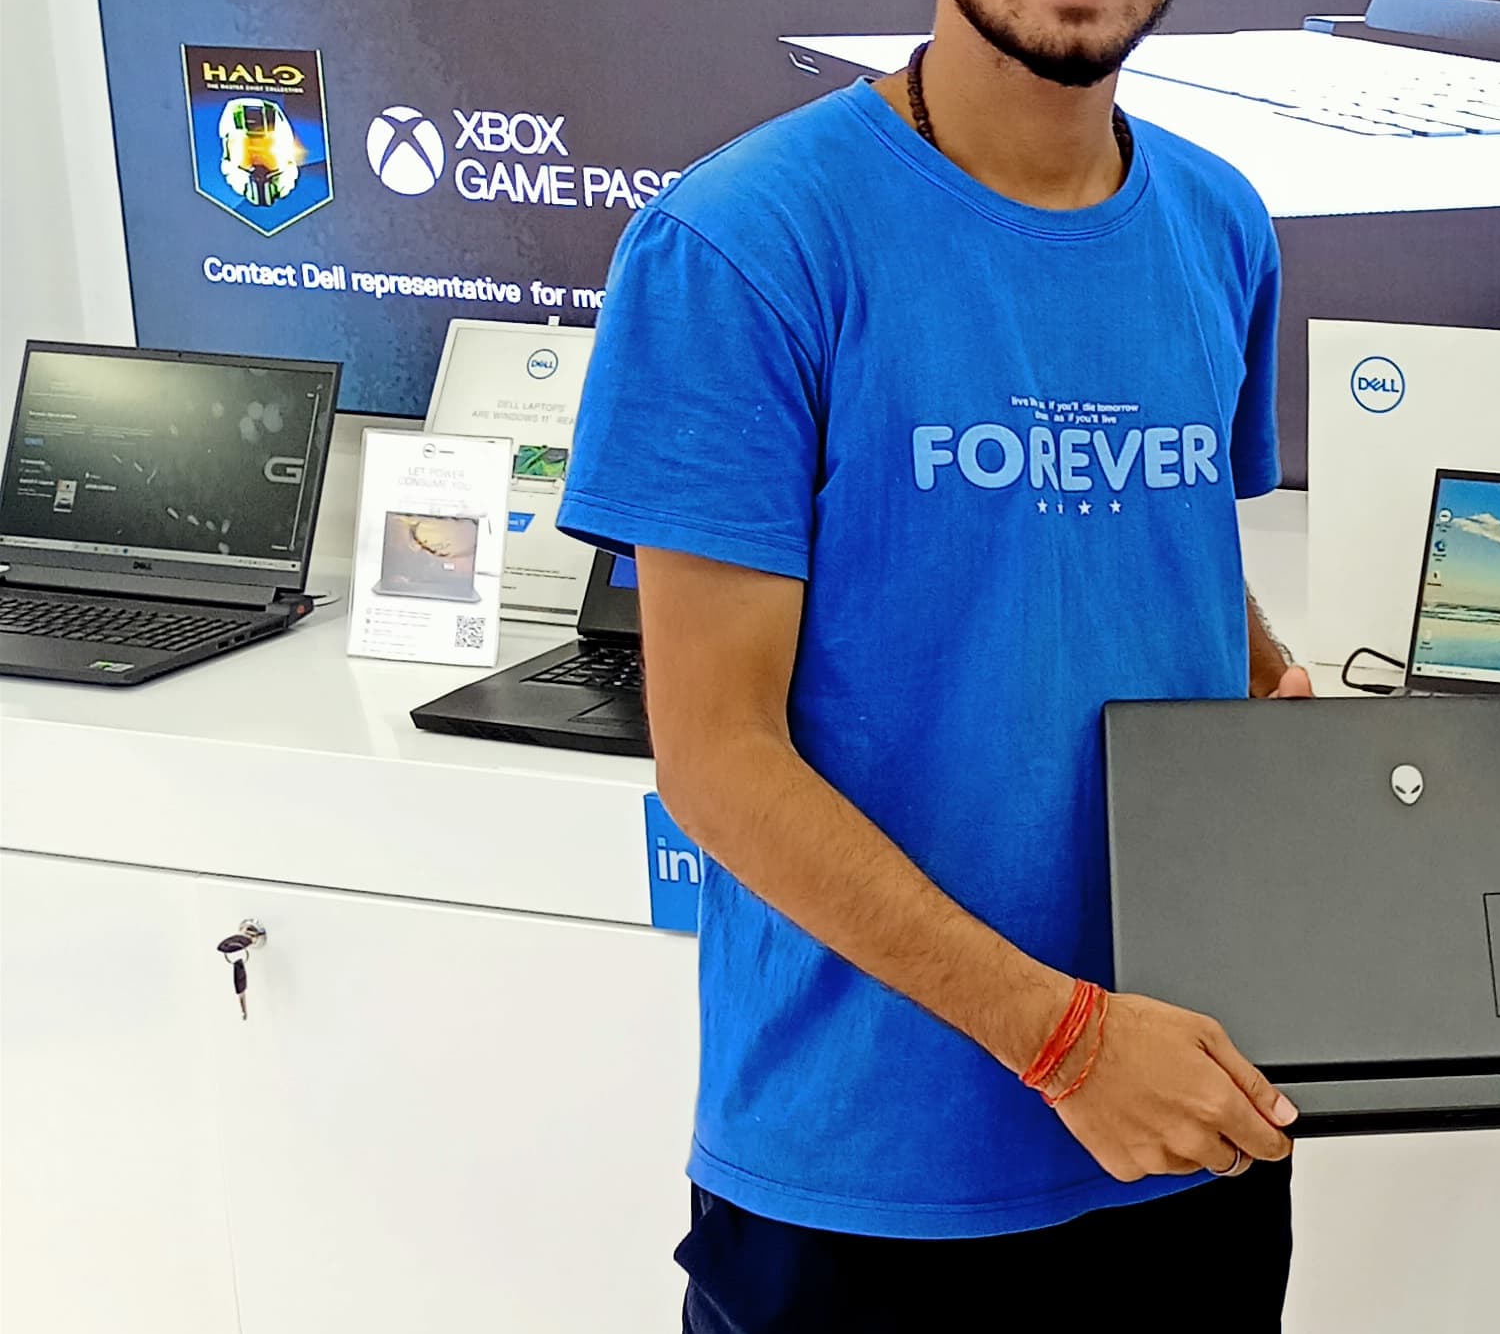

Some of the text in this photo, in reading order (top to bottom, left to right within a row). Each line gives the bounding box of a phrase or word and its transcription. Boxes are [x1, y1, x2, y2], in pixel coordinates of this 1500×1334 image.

[202, 62, 304, 86] HALO
[453, 109, 569, 156] XBOX
[455, 158, 578, 206] GAME
[202, 257, 607, 309] Contact Dell representative for mo
[1097, 403, 1139, 412] tomorrow
[1358, 377, 1399, 393] DELL
[912, 423, 1219, 492] FOREVER
